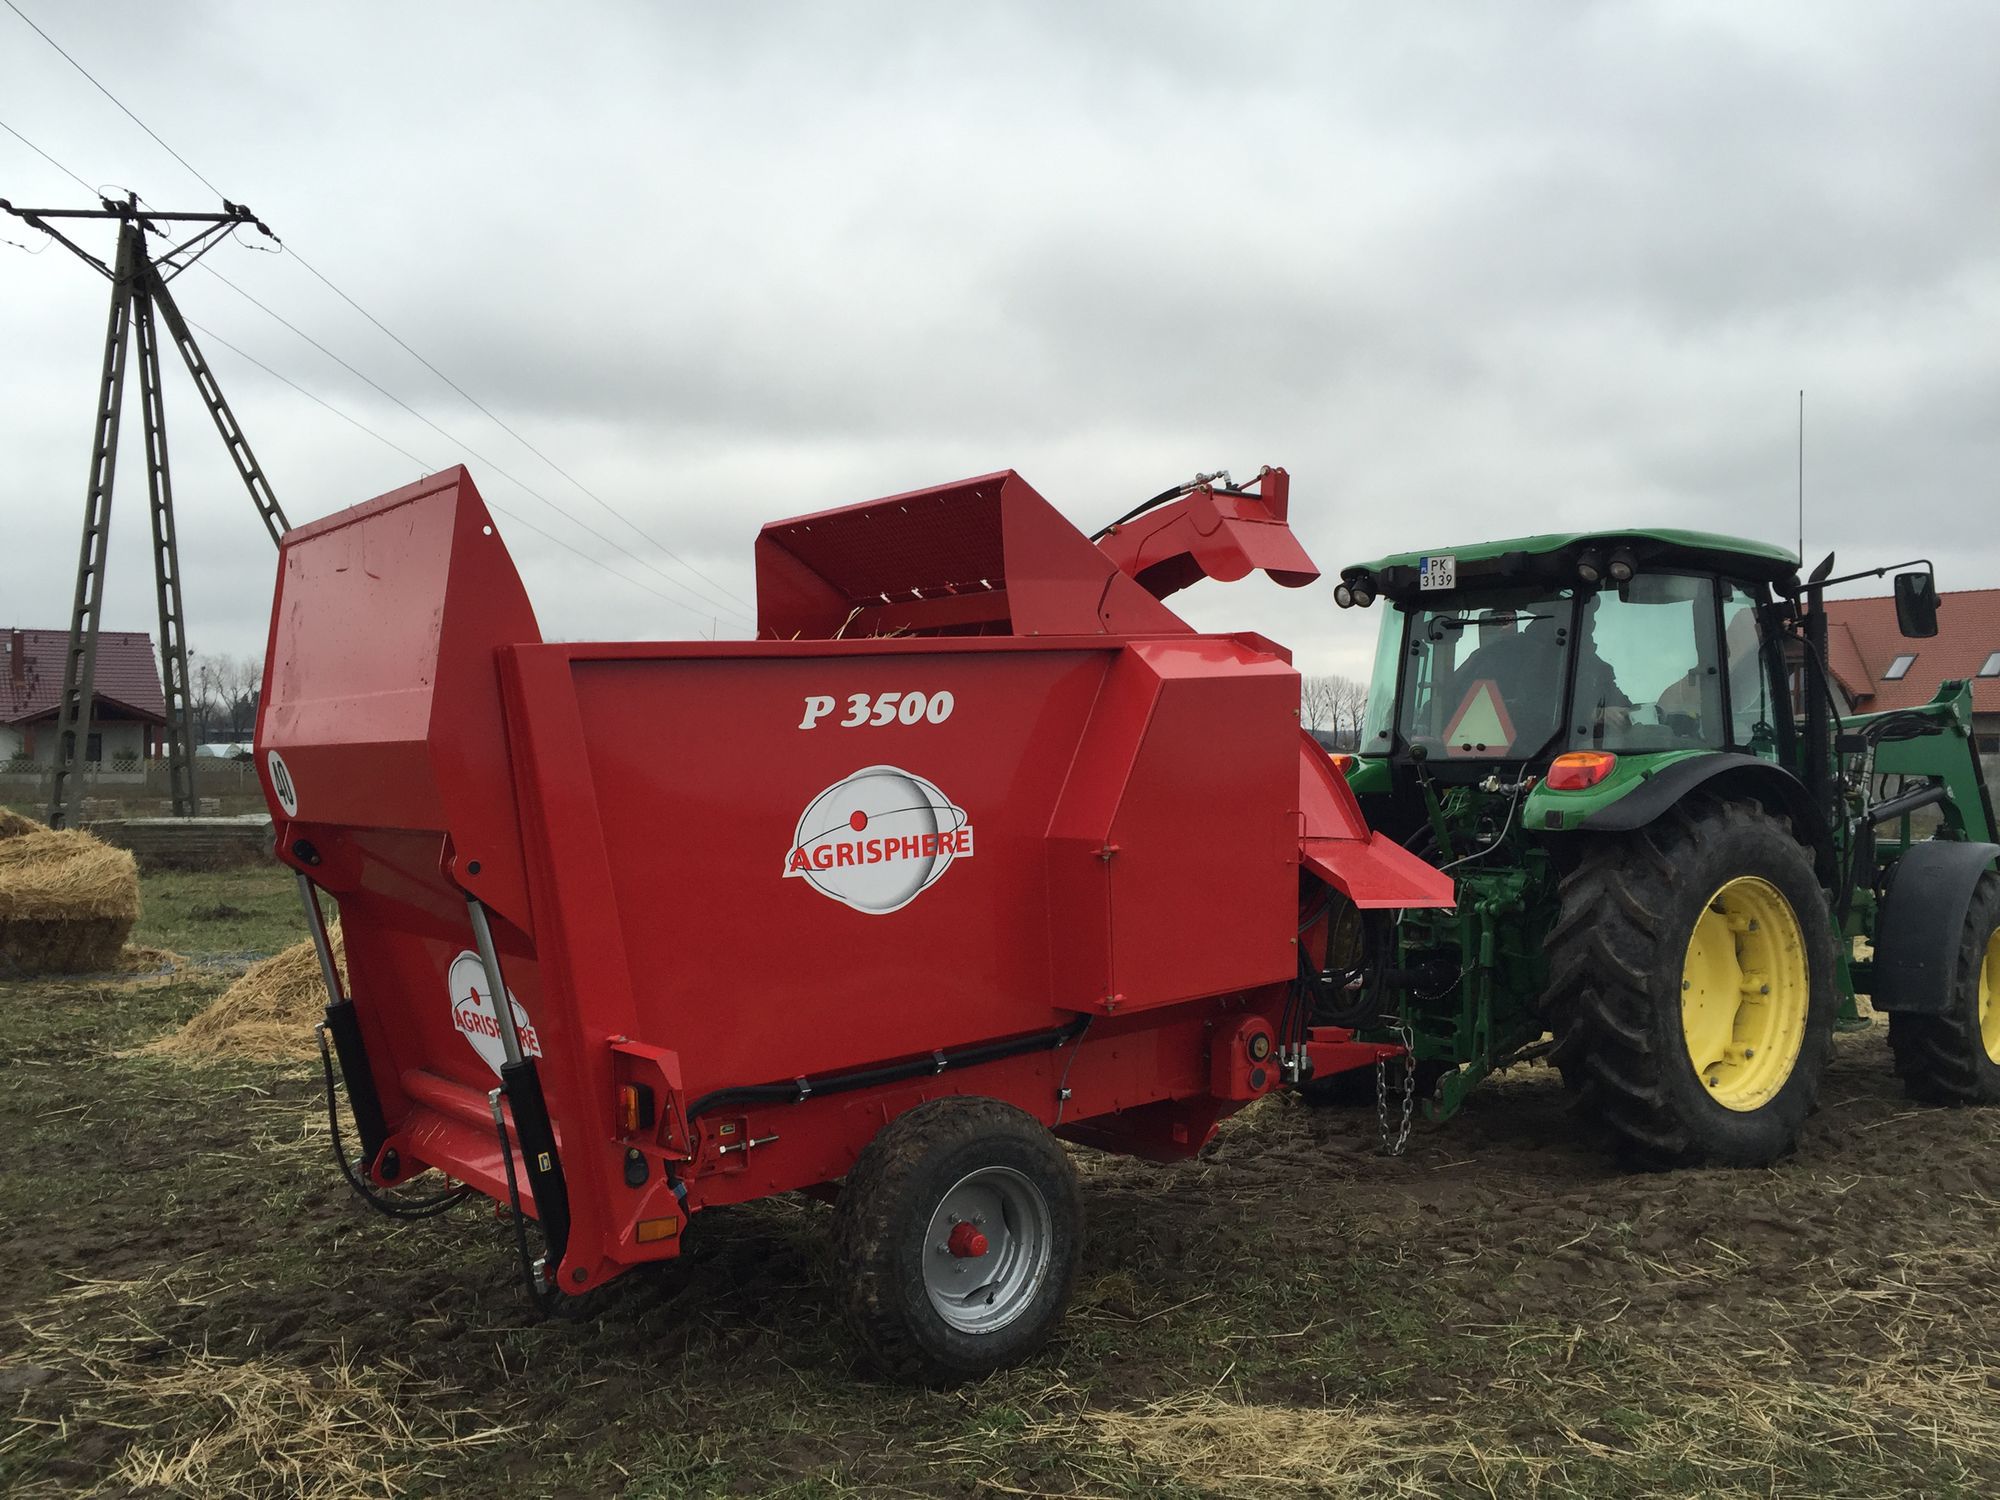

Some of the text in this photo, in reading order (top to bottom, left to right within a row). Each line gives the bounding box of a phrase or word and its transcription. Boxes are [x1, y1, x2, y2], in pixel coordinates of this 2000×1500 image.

[1422, 574, 1453, 587] 3139
[1431, 559, 1447, 571] PK
[798, 690, 955, 730] P 3500
[271, 760, 294, 806] 40
[789, 830, 970, 873] AGRISPHERE
